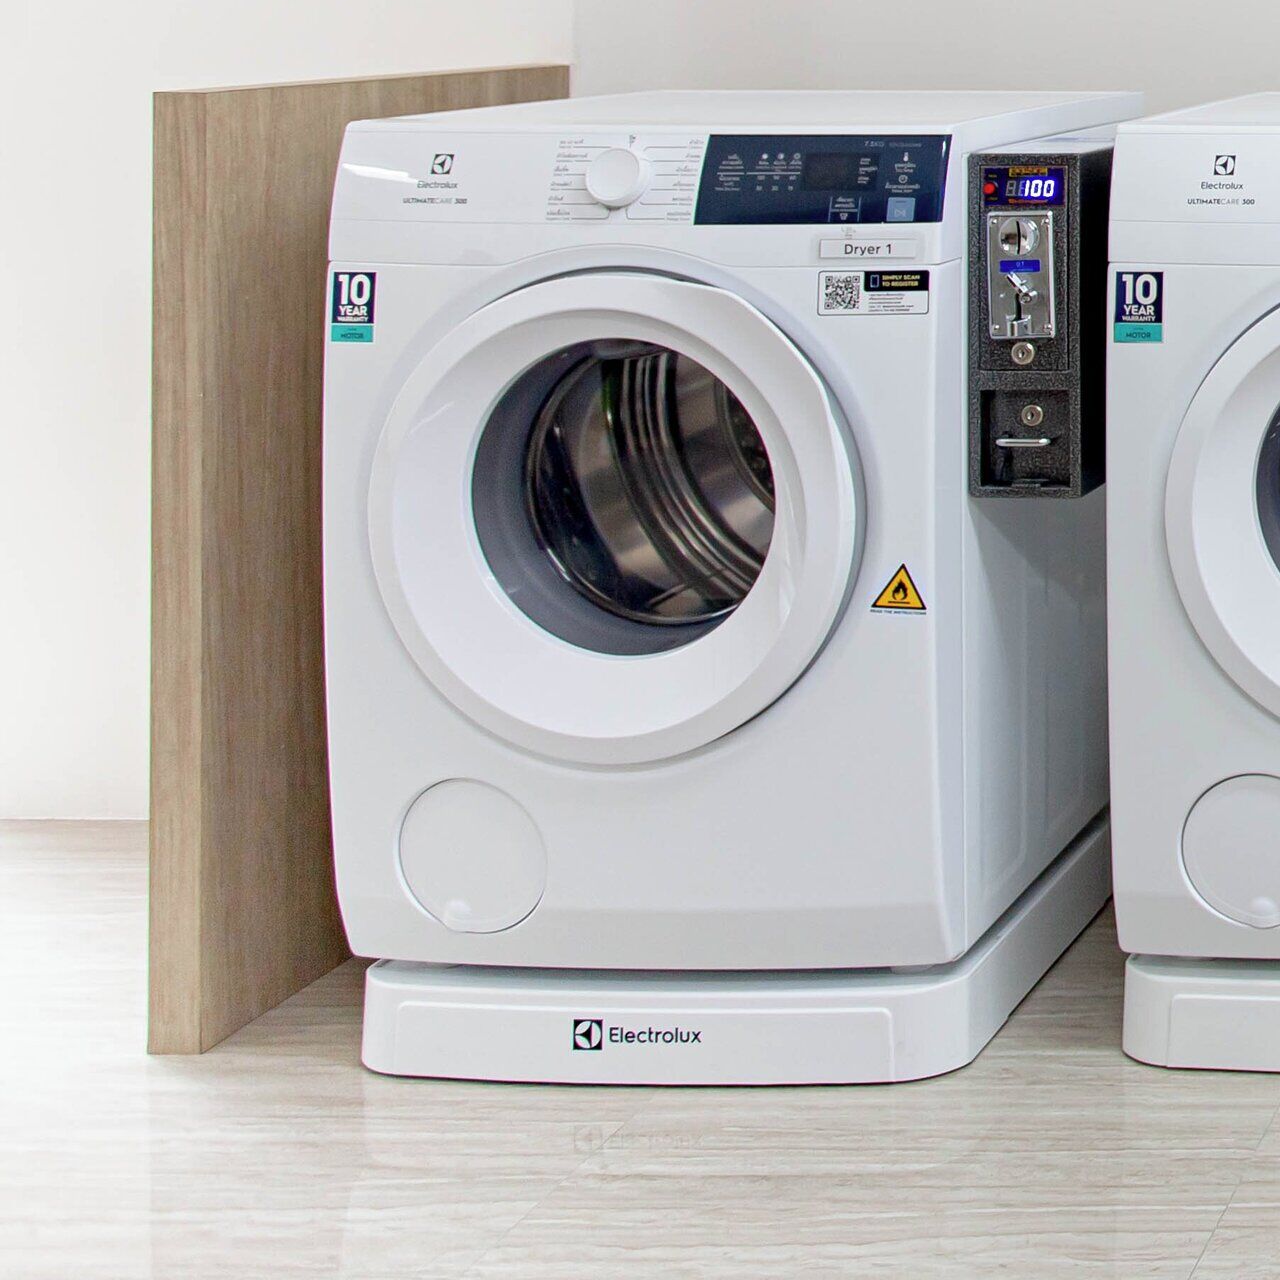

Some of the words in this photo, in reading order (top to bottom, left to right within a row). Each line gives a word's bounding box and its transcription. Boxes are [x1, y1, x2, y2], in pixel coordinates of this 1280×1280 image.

[416, 180, 458, 189] Electrolux
[1024, 179, 1055, 197] 100
[1200, 181, 1244, 189] Electrolux
[844, 243, 881, 257] Dryer
[886, 243, 892, 255] 1
[338, 274, 371, 305] 10
[1122, 274, 1157, 305] 10
[338, 305, 368, 315] YEAR
[1123, 305, 1155, 315] YEAR
[609, 1027, 702, 1044] Electrolux
